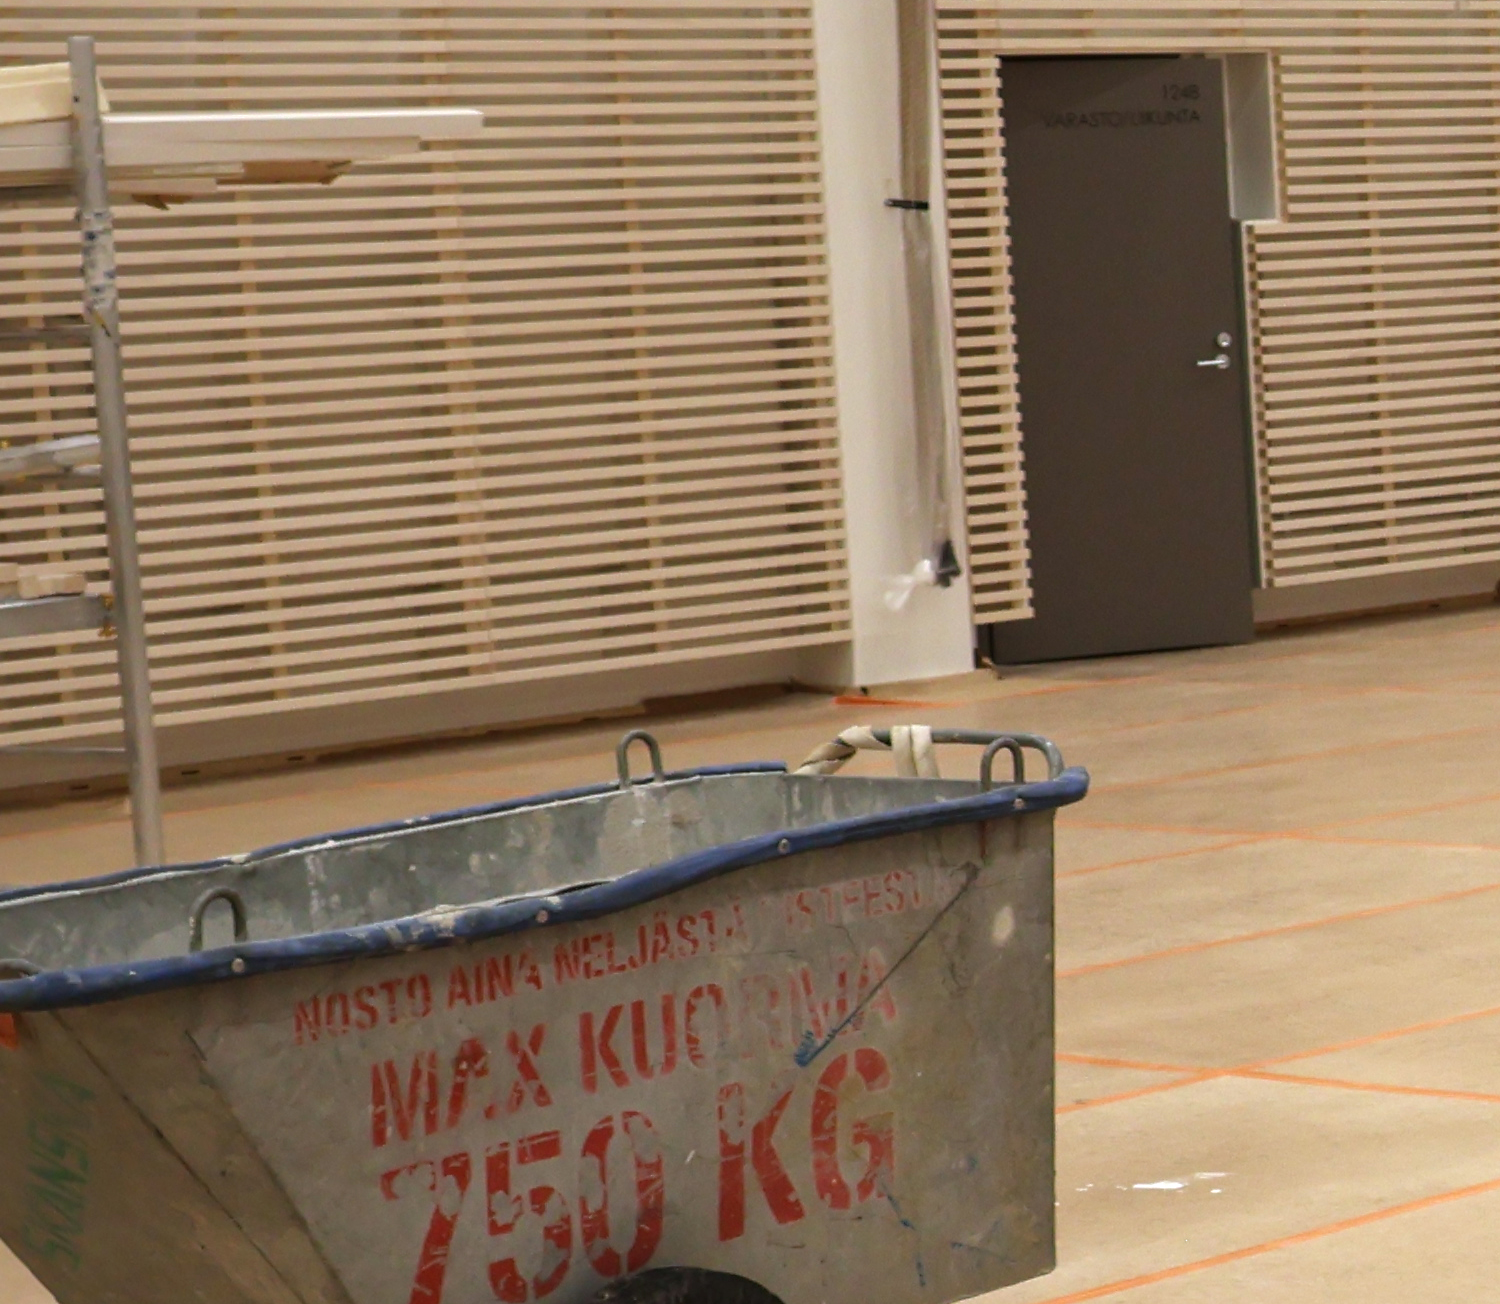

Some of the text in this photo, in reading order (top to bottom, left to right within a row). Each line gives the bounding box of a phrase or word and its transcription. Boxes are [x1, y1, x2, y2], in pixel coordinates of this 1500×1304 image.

[293, 973, 433, 1045] NOSTO
[448, 950, 543, 1009] AINA
[369, 1022, 553, 1148] MAX
[717, 1046, 894, 1242] KG
